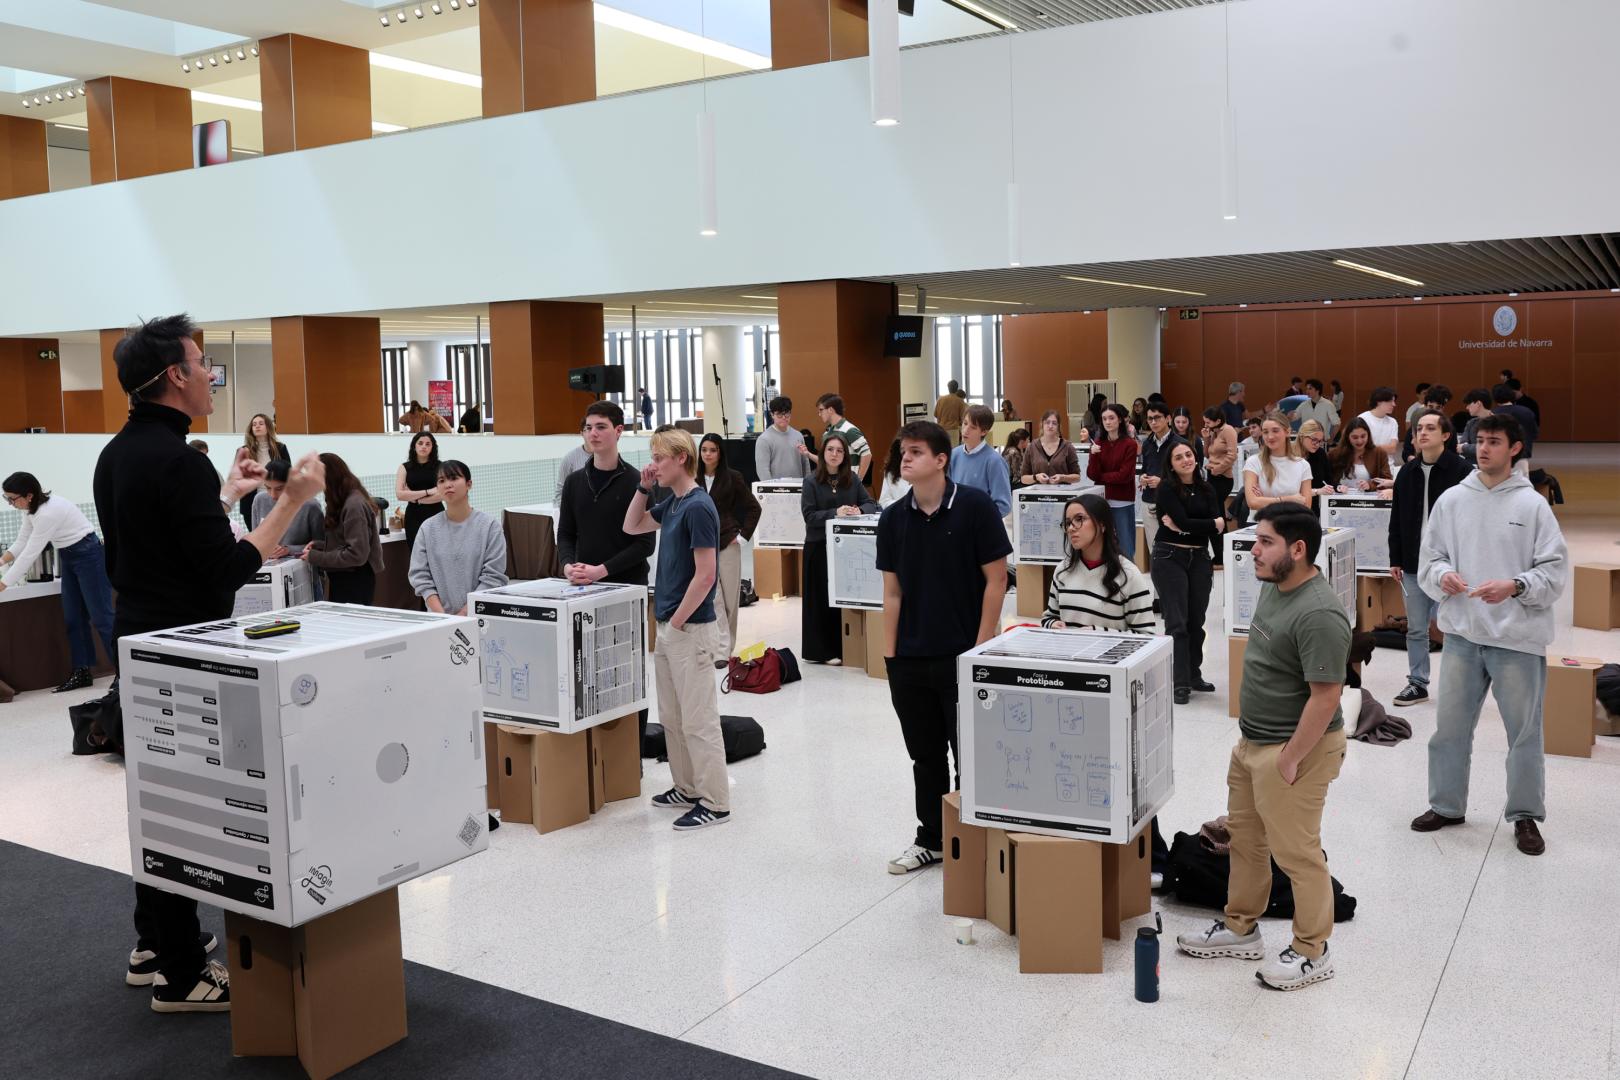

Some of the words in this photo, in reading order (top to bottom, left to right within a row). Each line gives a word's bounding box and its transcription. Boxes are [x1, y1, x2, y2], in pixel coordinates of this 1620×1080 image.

[1458, 339, 1505, 350] Universidad
[1507, 339, 1518, 349] de
[1519, 338, 1553, 348] Navarra
[501, 609, 529, 617] Prototipado
[1017, 676, 1064, 687] Prototipado
[183, 864, 224, 886] Inspiración
[309, 865, 333, 887] imagin
